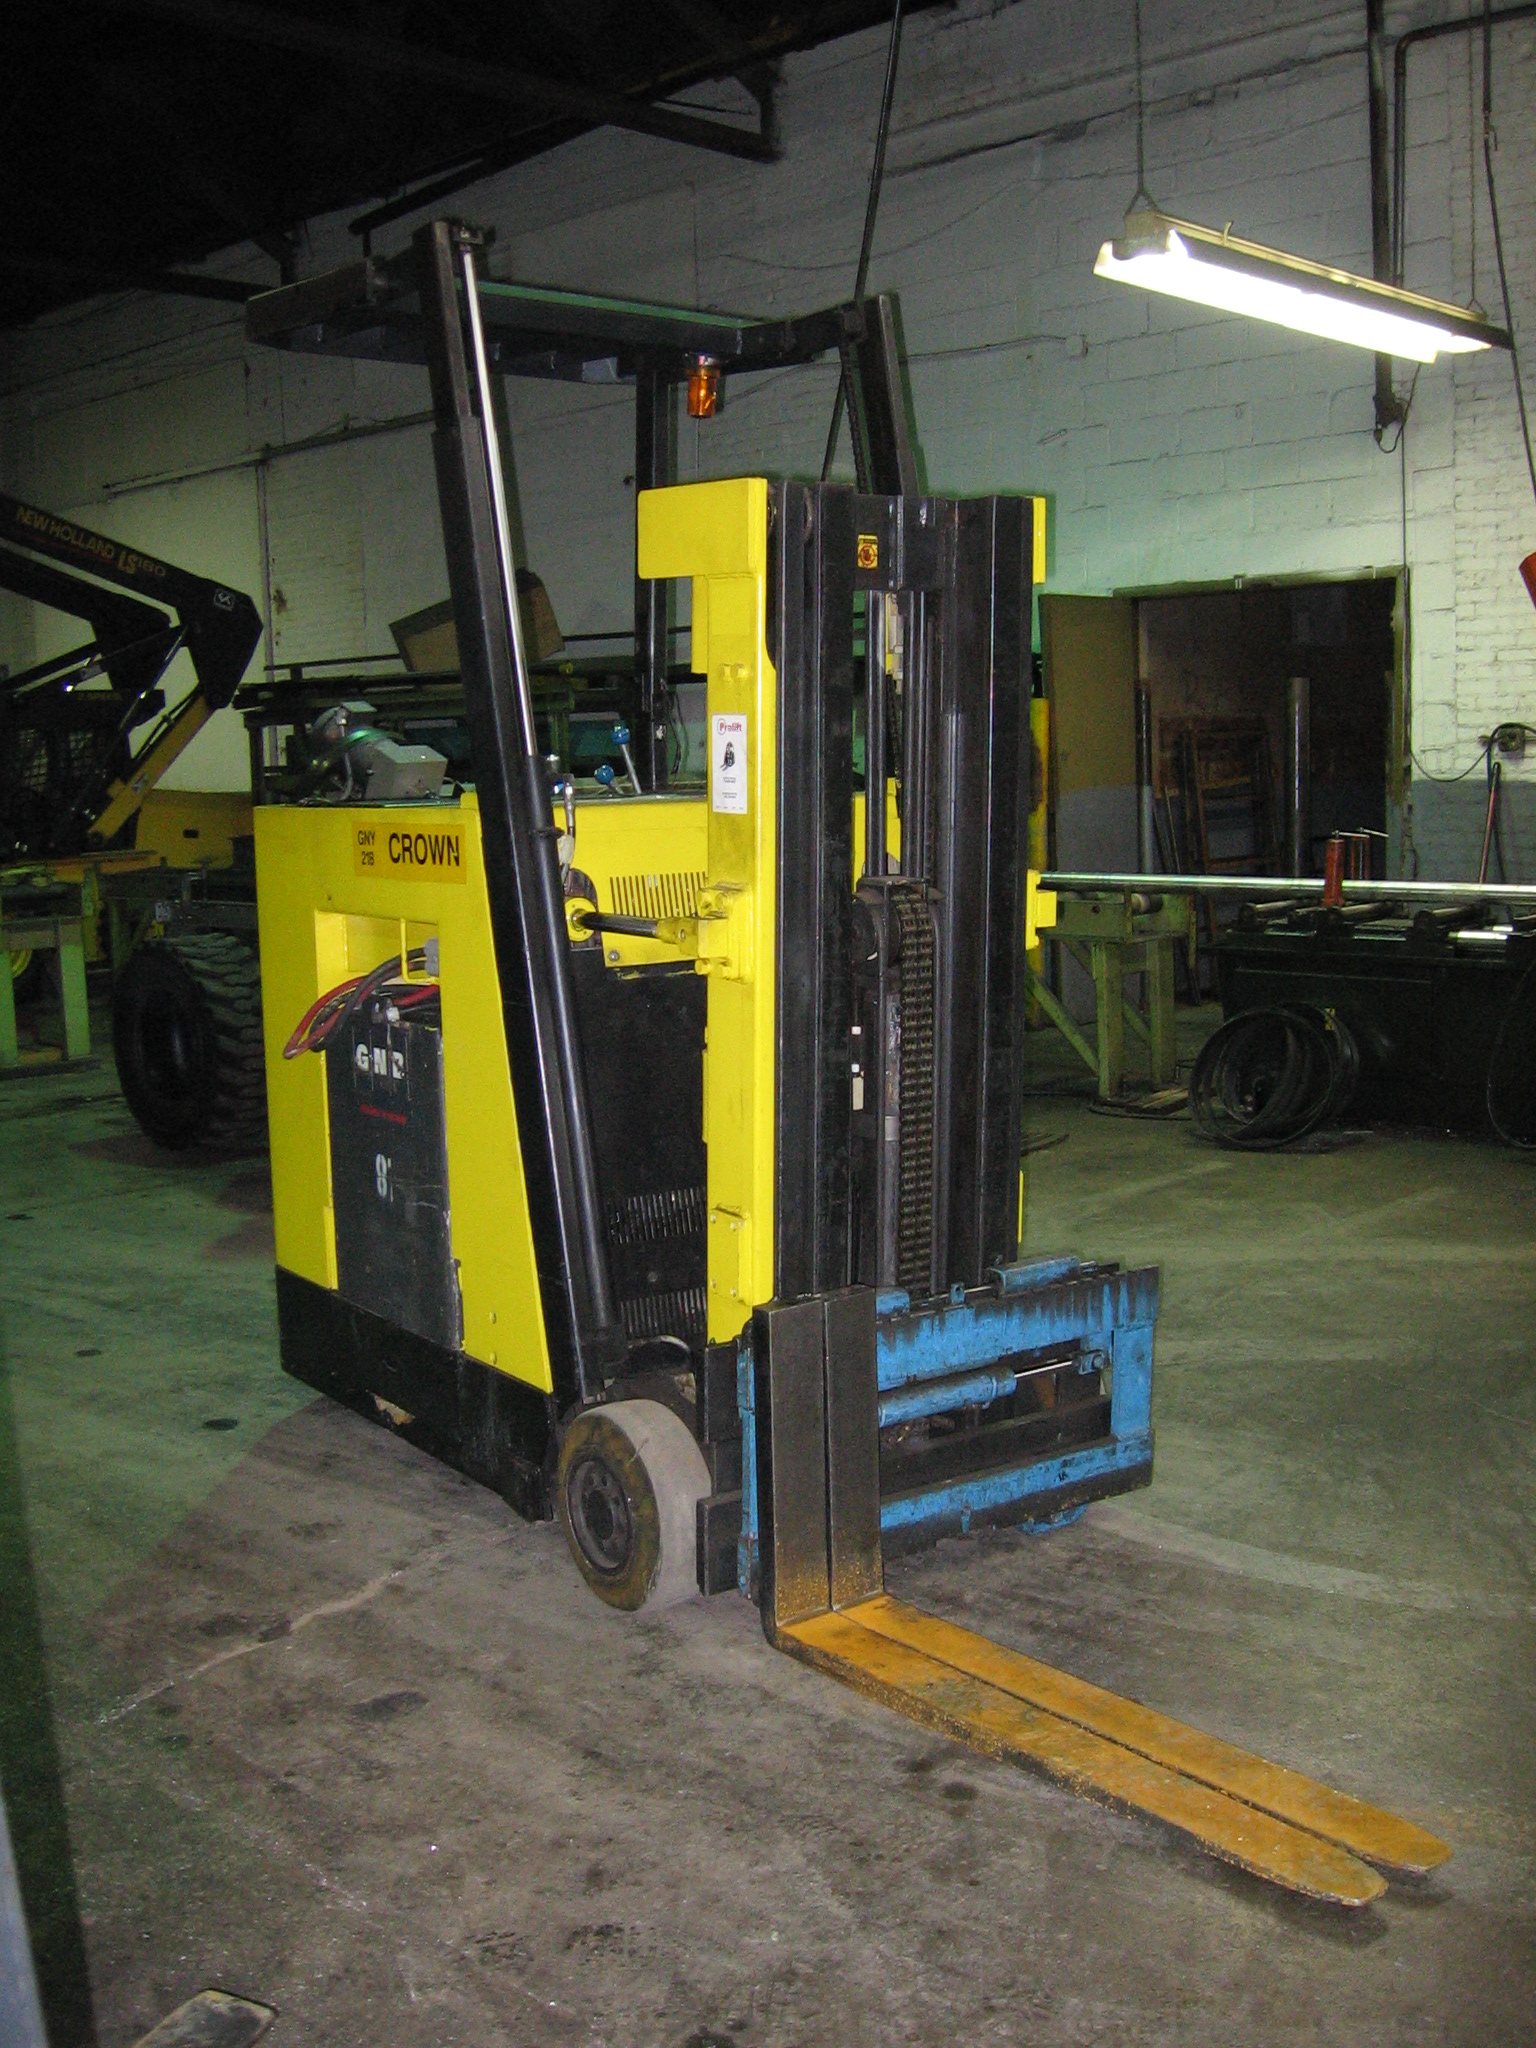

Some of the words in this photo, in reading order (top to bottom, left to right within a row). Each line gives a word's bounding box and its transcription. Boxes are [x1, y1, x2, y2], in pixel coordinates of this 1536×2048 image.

[15, 504, 49, 532] NEW
[49, 520, 115, 560] HOLLAND
[388, 832, 460, 867] CROWN
